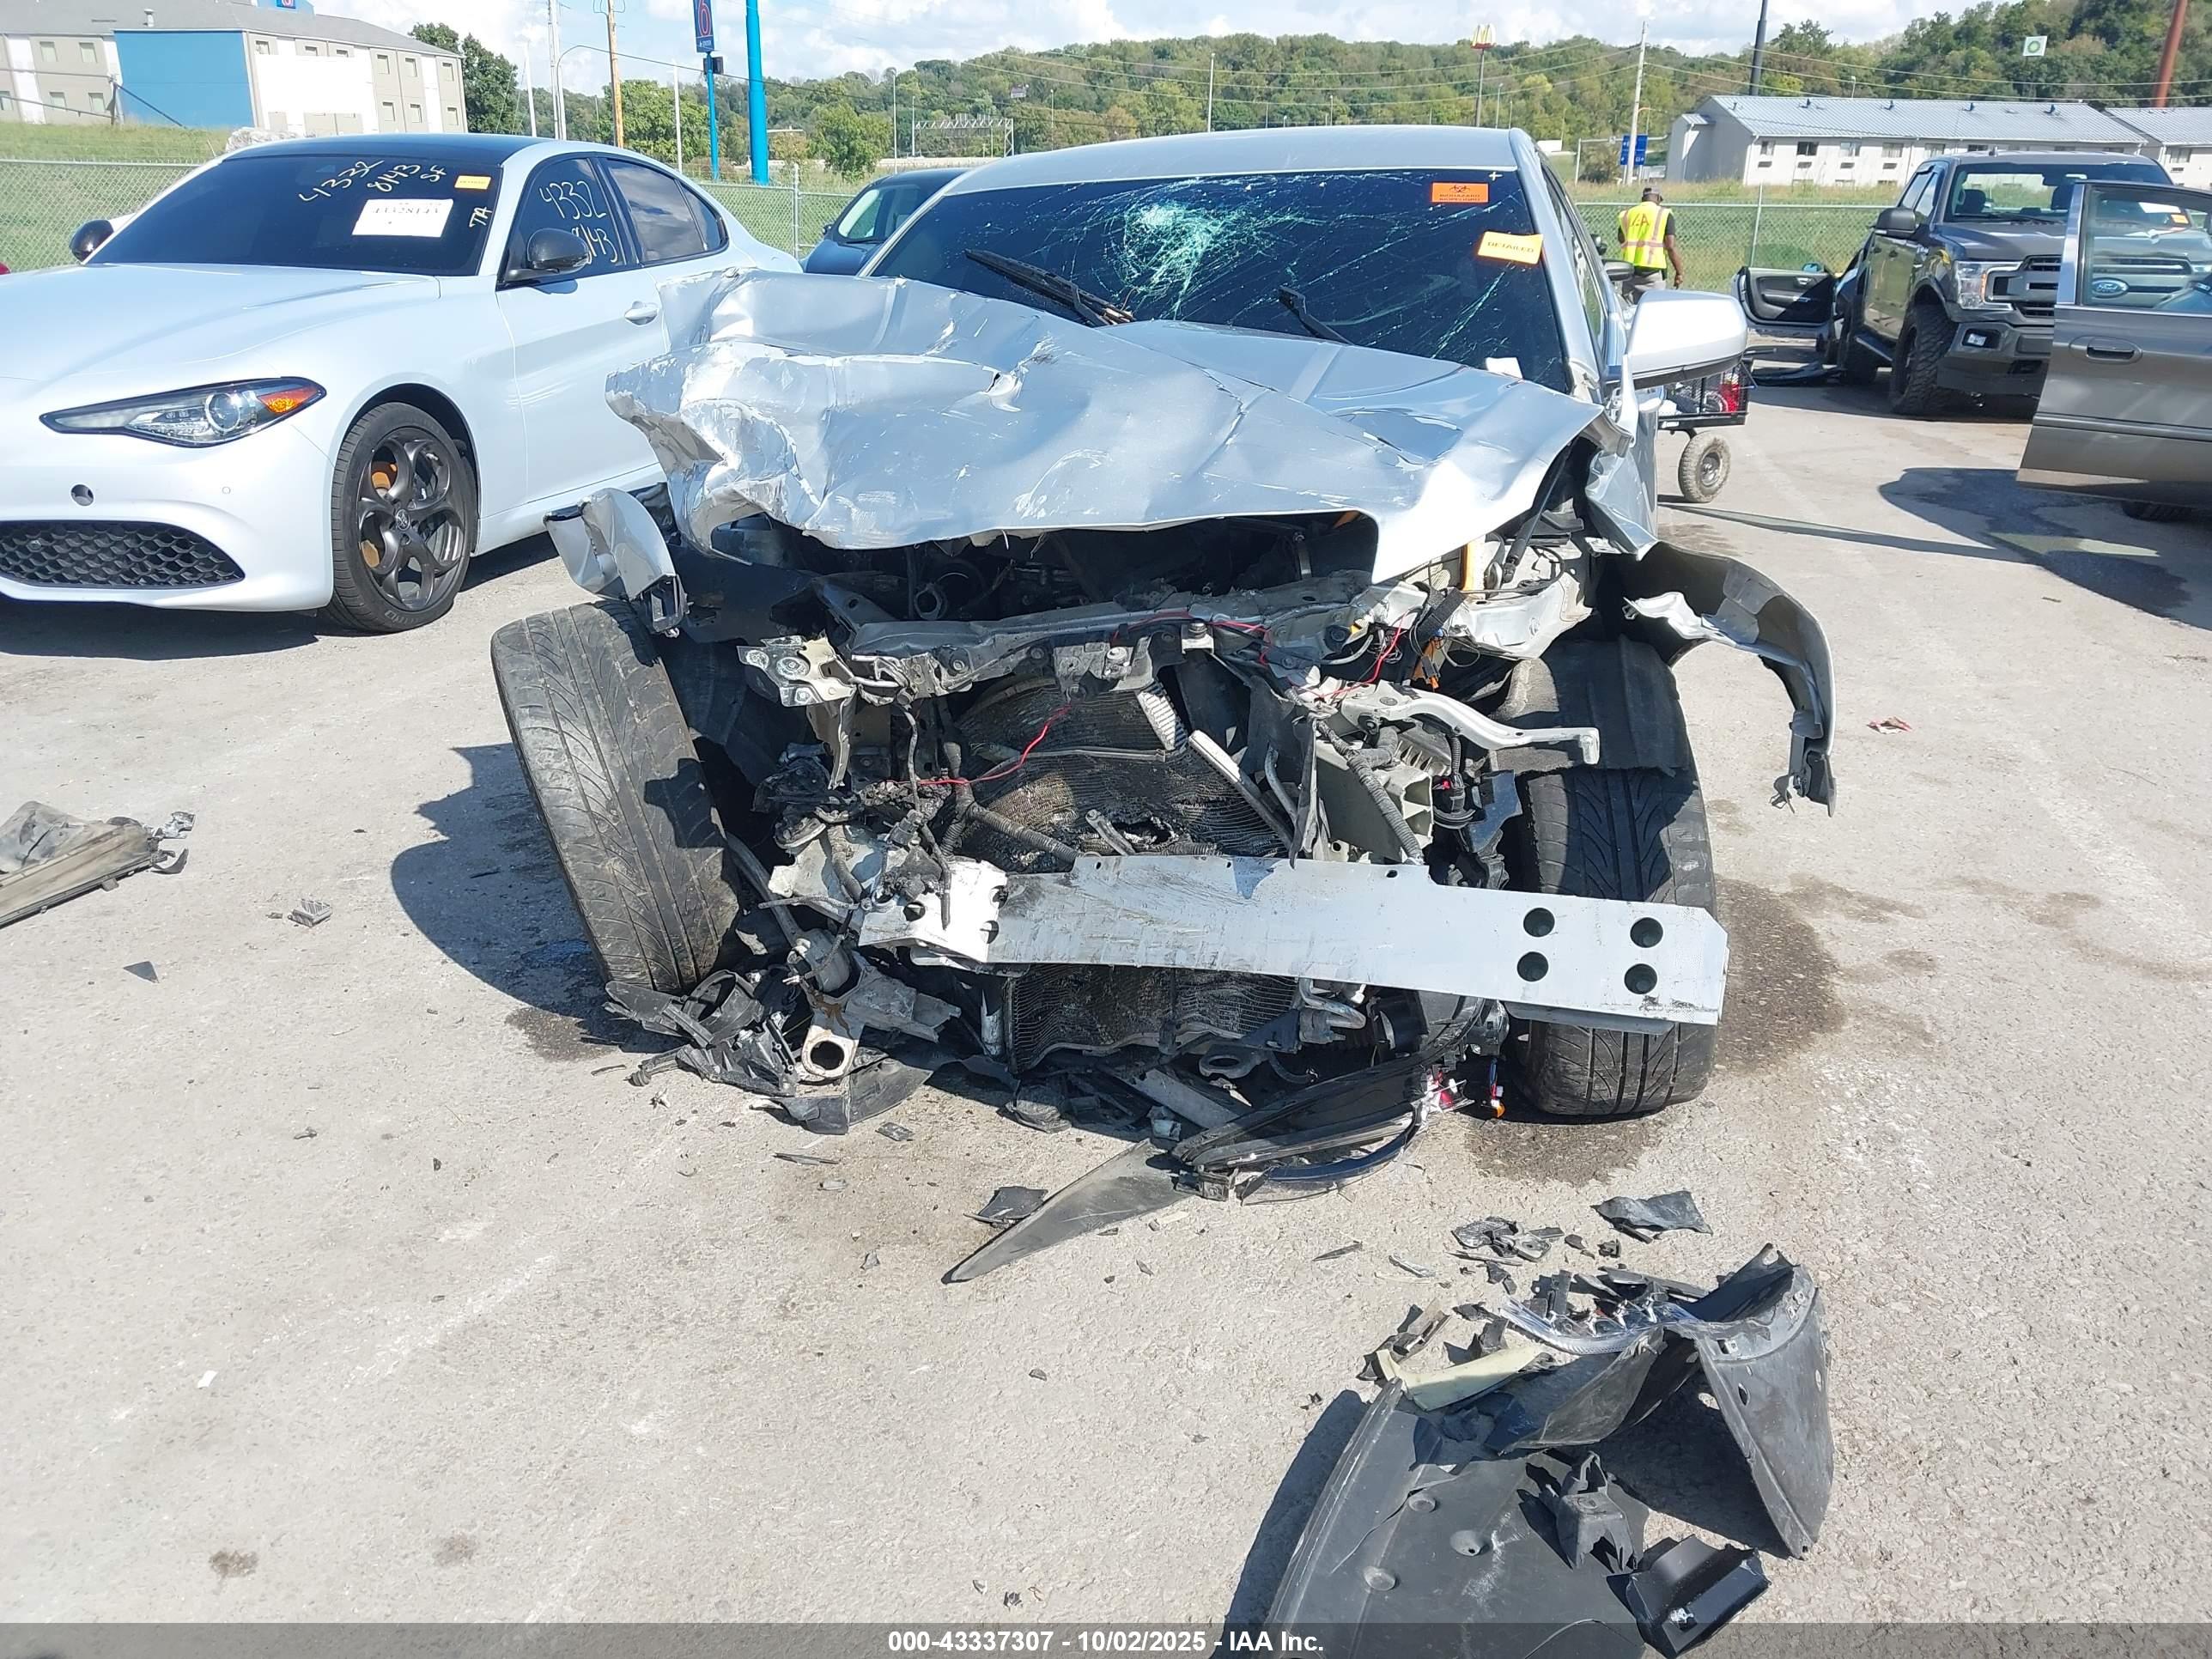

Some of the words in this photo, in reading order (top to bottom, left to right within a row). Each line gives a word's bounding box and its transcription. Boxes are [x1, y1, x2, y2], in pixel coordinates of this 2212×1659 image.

[298, 160, 385, 201] 4332
[367, 164, 421, 191] 8143
[538, 180, 607, 219] 4332
[1486, 241, 1534, 253] DETAILED
